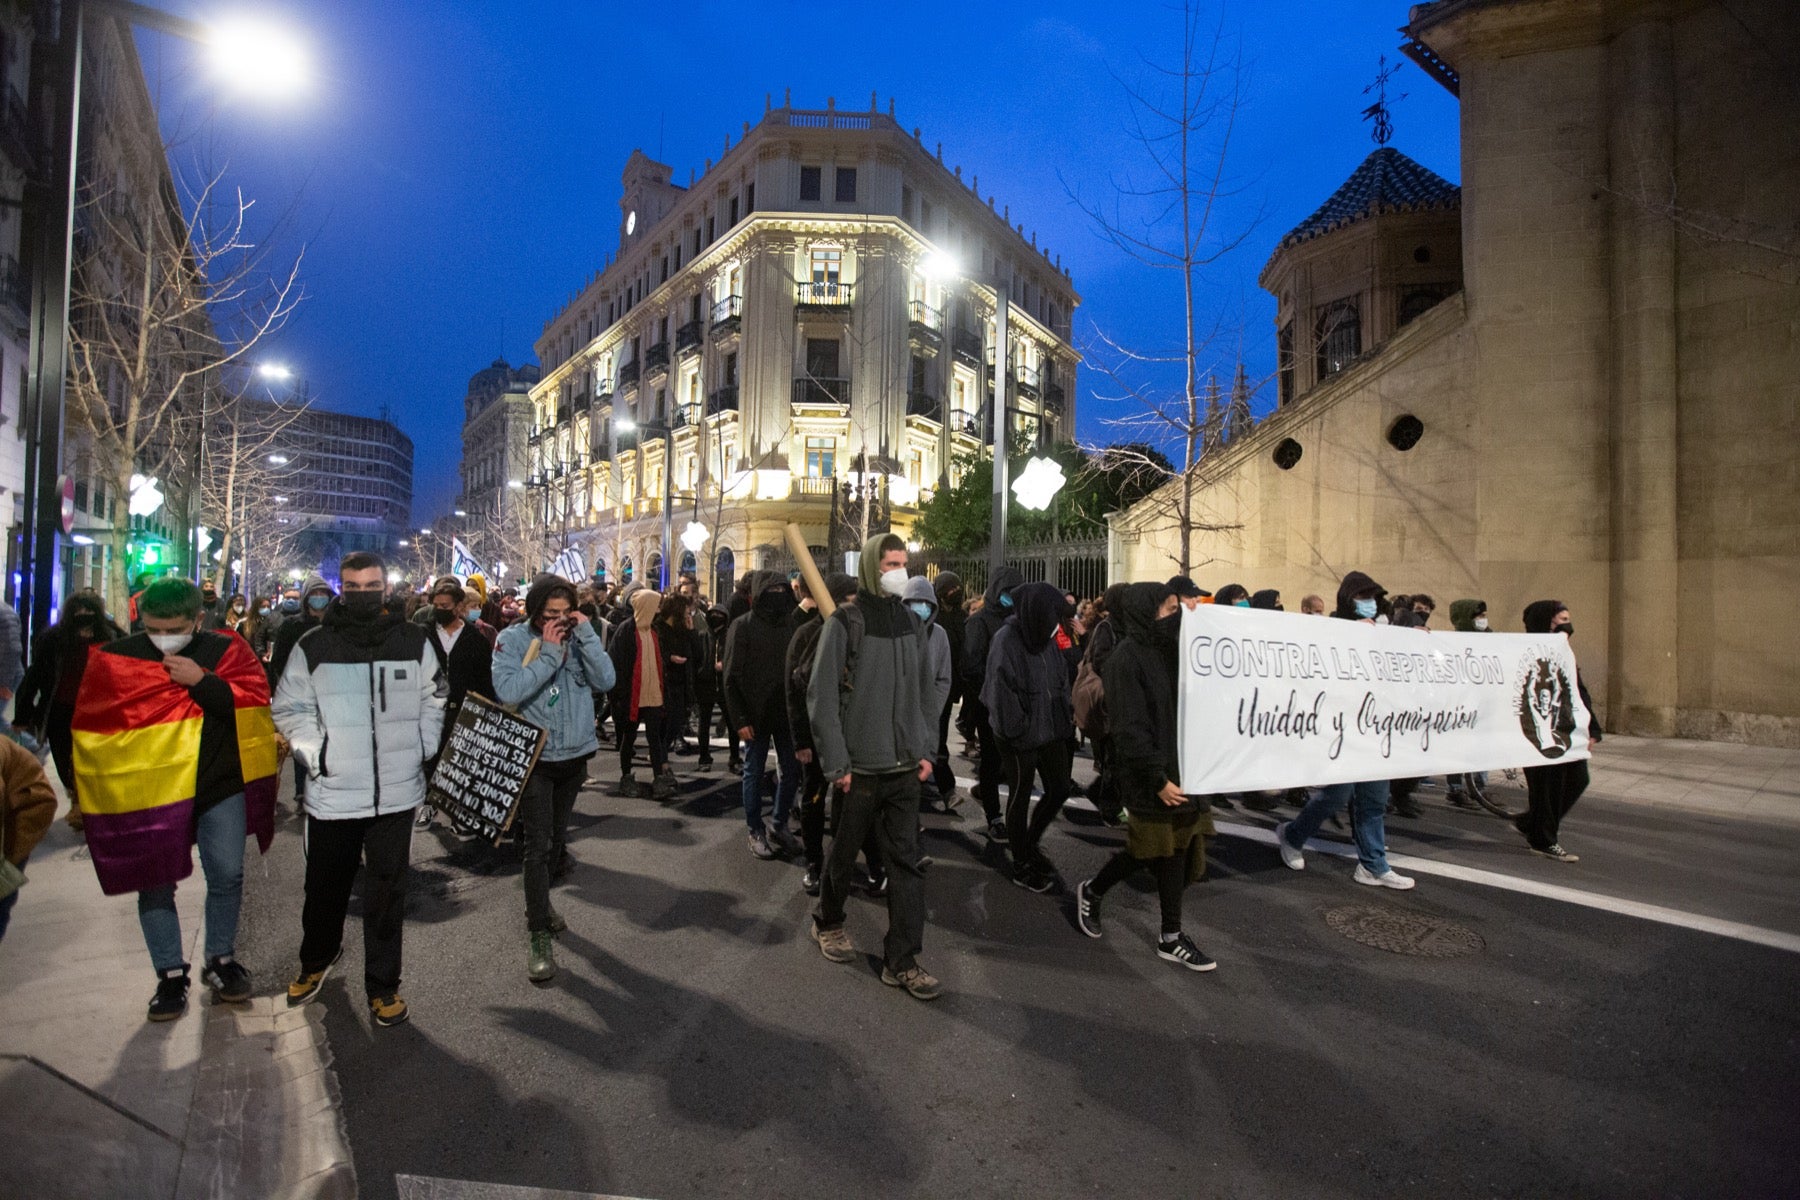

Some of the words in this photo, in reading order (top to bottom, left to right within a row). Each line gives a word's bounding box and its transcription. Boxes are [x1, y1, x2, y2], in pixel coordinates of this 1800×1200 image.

[1190, 635, 1329, 679] CONTRA
[1331, 646, 1370, 681] LA
[1368, 647, 1505, 685] REPRESIÓN
[472, 717, 527, 750] TOTALMENTE
[1237, 686, 1326, 740] Unidad
[1328, 711, 1344, 760] y
[453, 723, 510, 757] HUMANAMENTE
[526, 742, 536, 754] Y
[452, 750, 521, 793] SOCIALMENTE
[510, 747, 531, 767] TES
[435, 758, 472, 788] SEAMOS
[461, 790, 480, 811] UN
[471, 778, 514, 808] DONDE
[479, 798, 507, 826] POR
